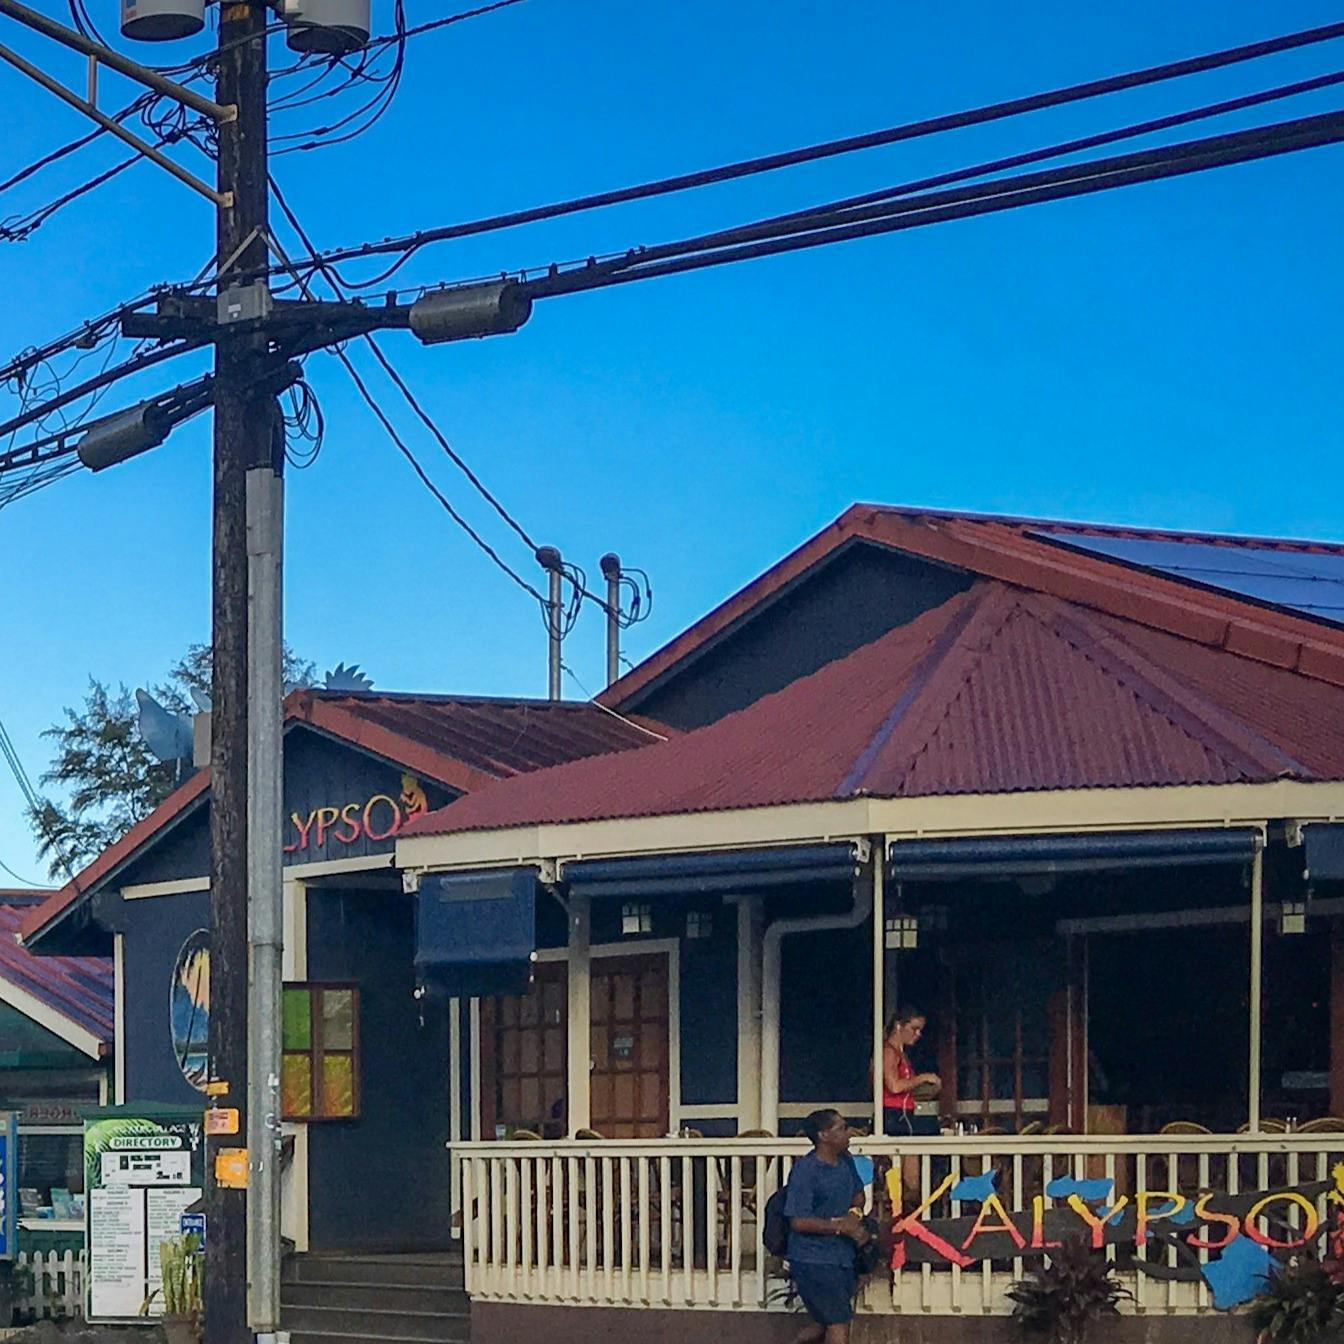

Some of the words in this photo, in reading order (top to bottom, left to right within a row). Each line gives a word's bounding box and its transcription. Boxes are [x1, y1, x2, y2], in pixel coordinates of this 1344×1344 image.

[283, 793, 402, 852] YPSO
[113, 1137, 178, 1148] DIRECTORY
[885, 1166, 1319, 1270] KALYPSO
